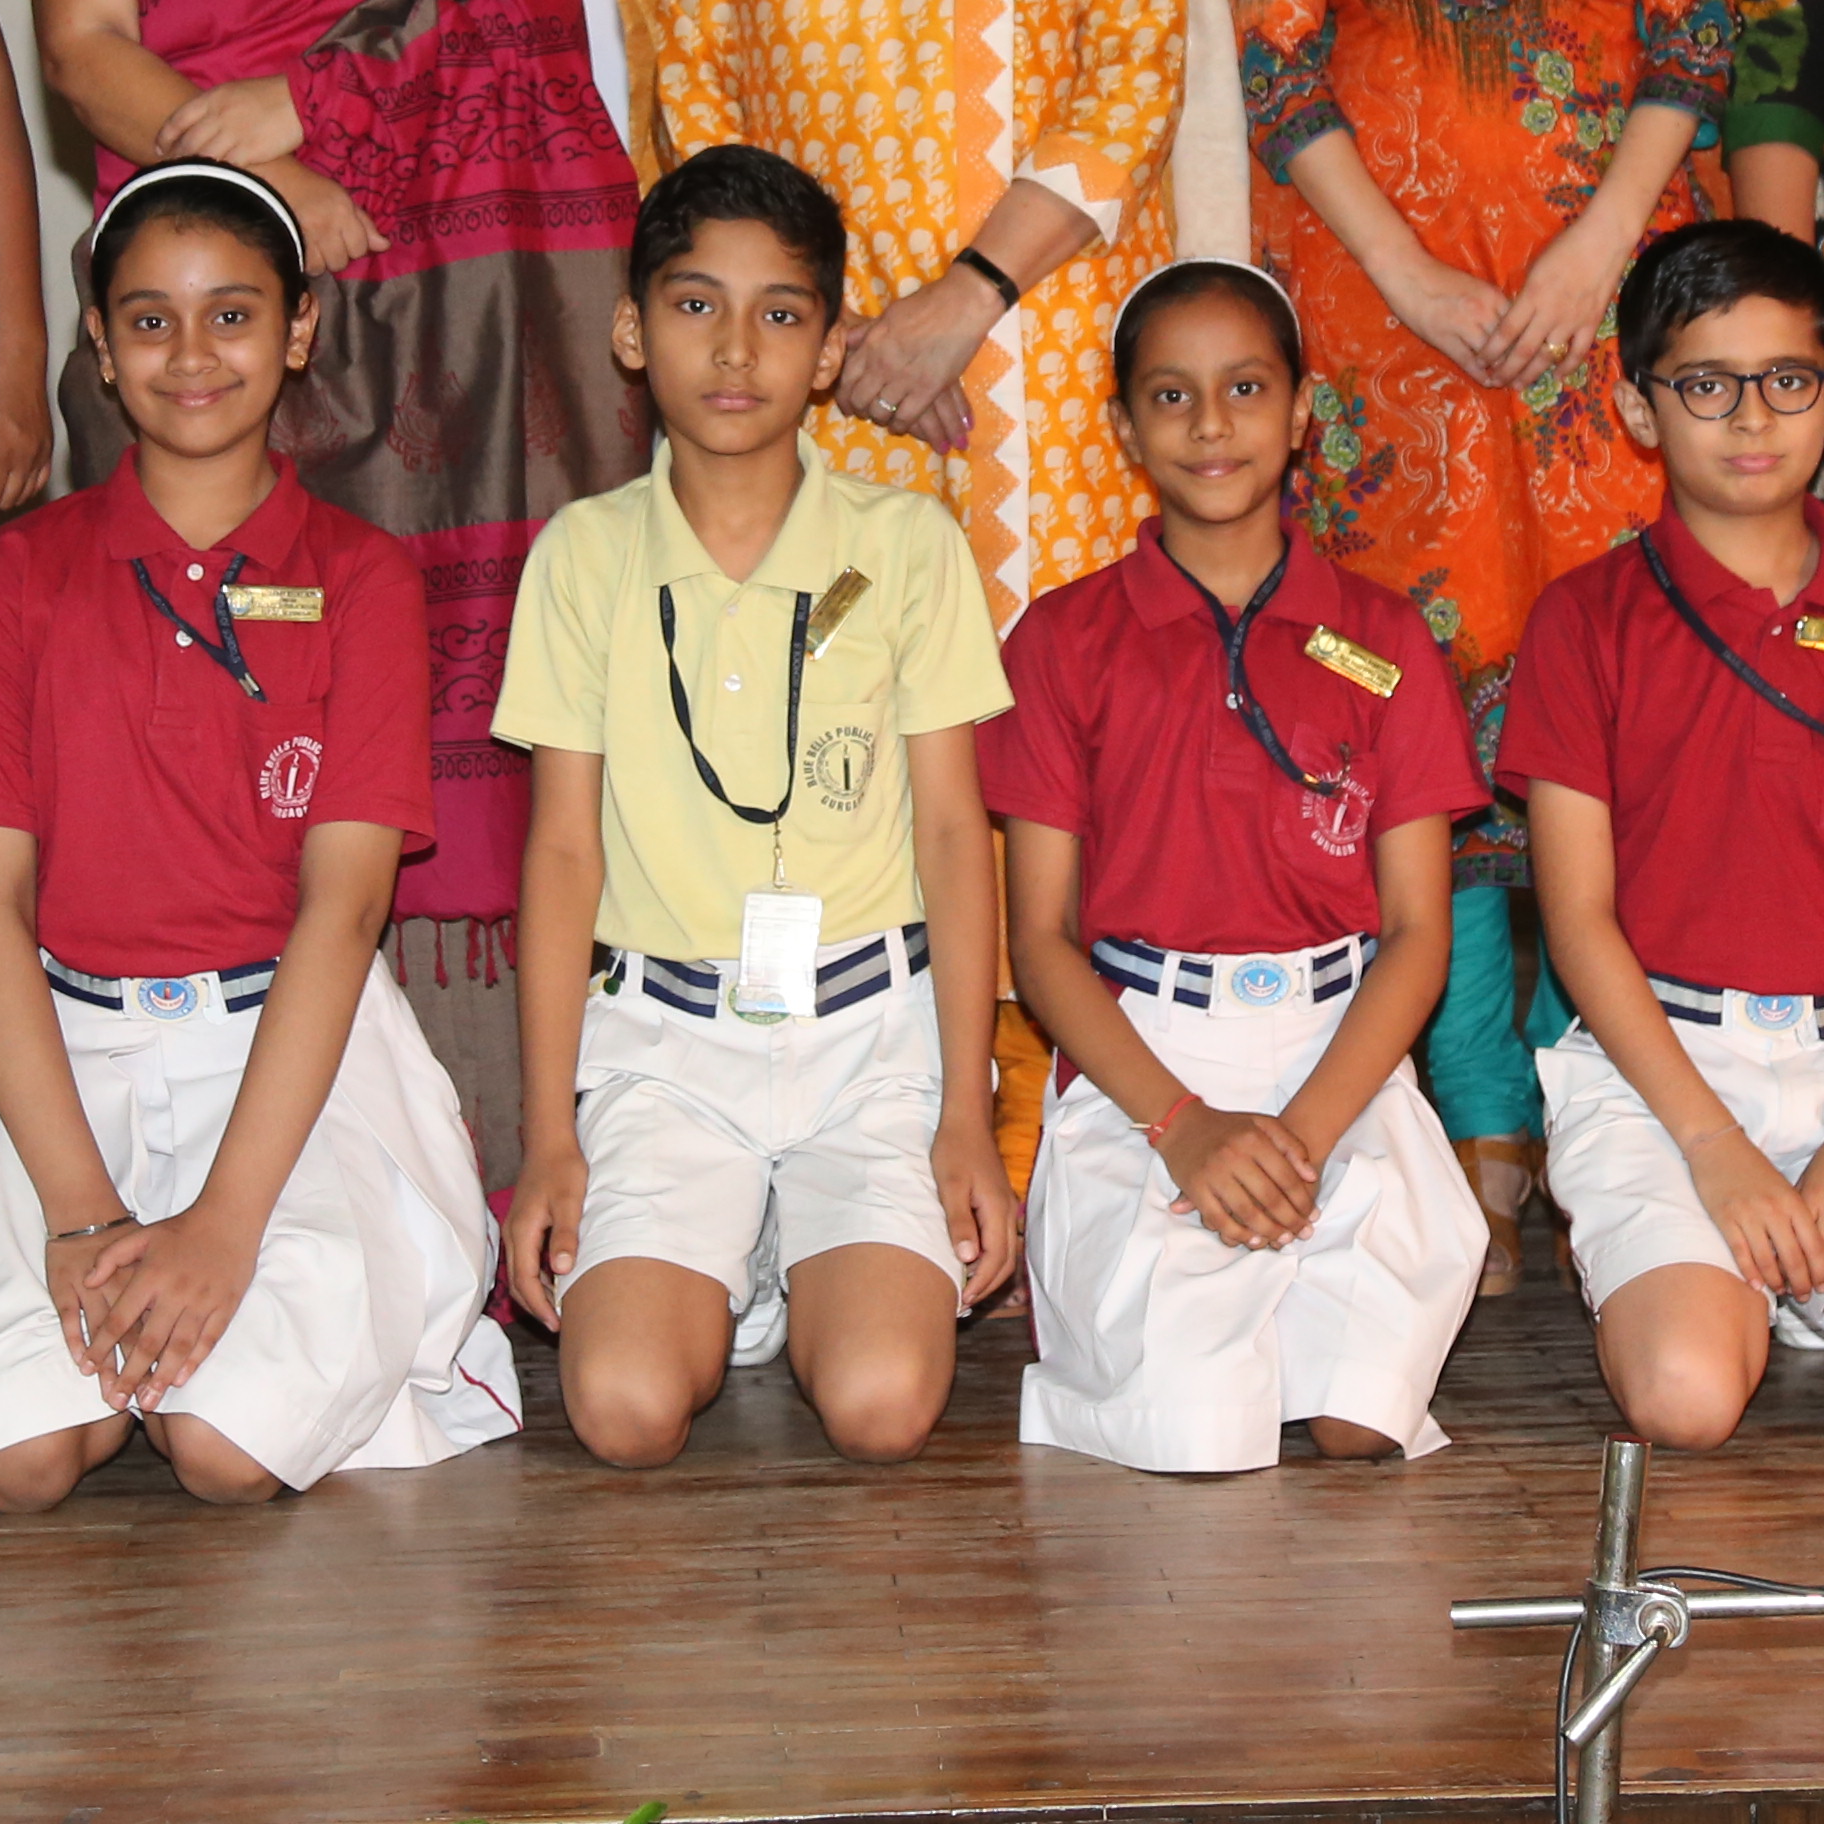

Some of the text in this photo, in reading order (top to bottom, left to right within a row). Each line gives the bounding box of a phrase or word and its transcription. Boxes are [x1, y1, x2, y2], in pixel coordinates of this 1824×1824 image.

[805, 731, 834, 758] BELLS
[836, 726, 874, 743] PUBLIC
[803, 760, 818, 789] BLUE
